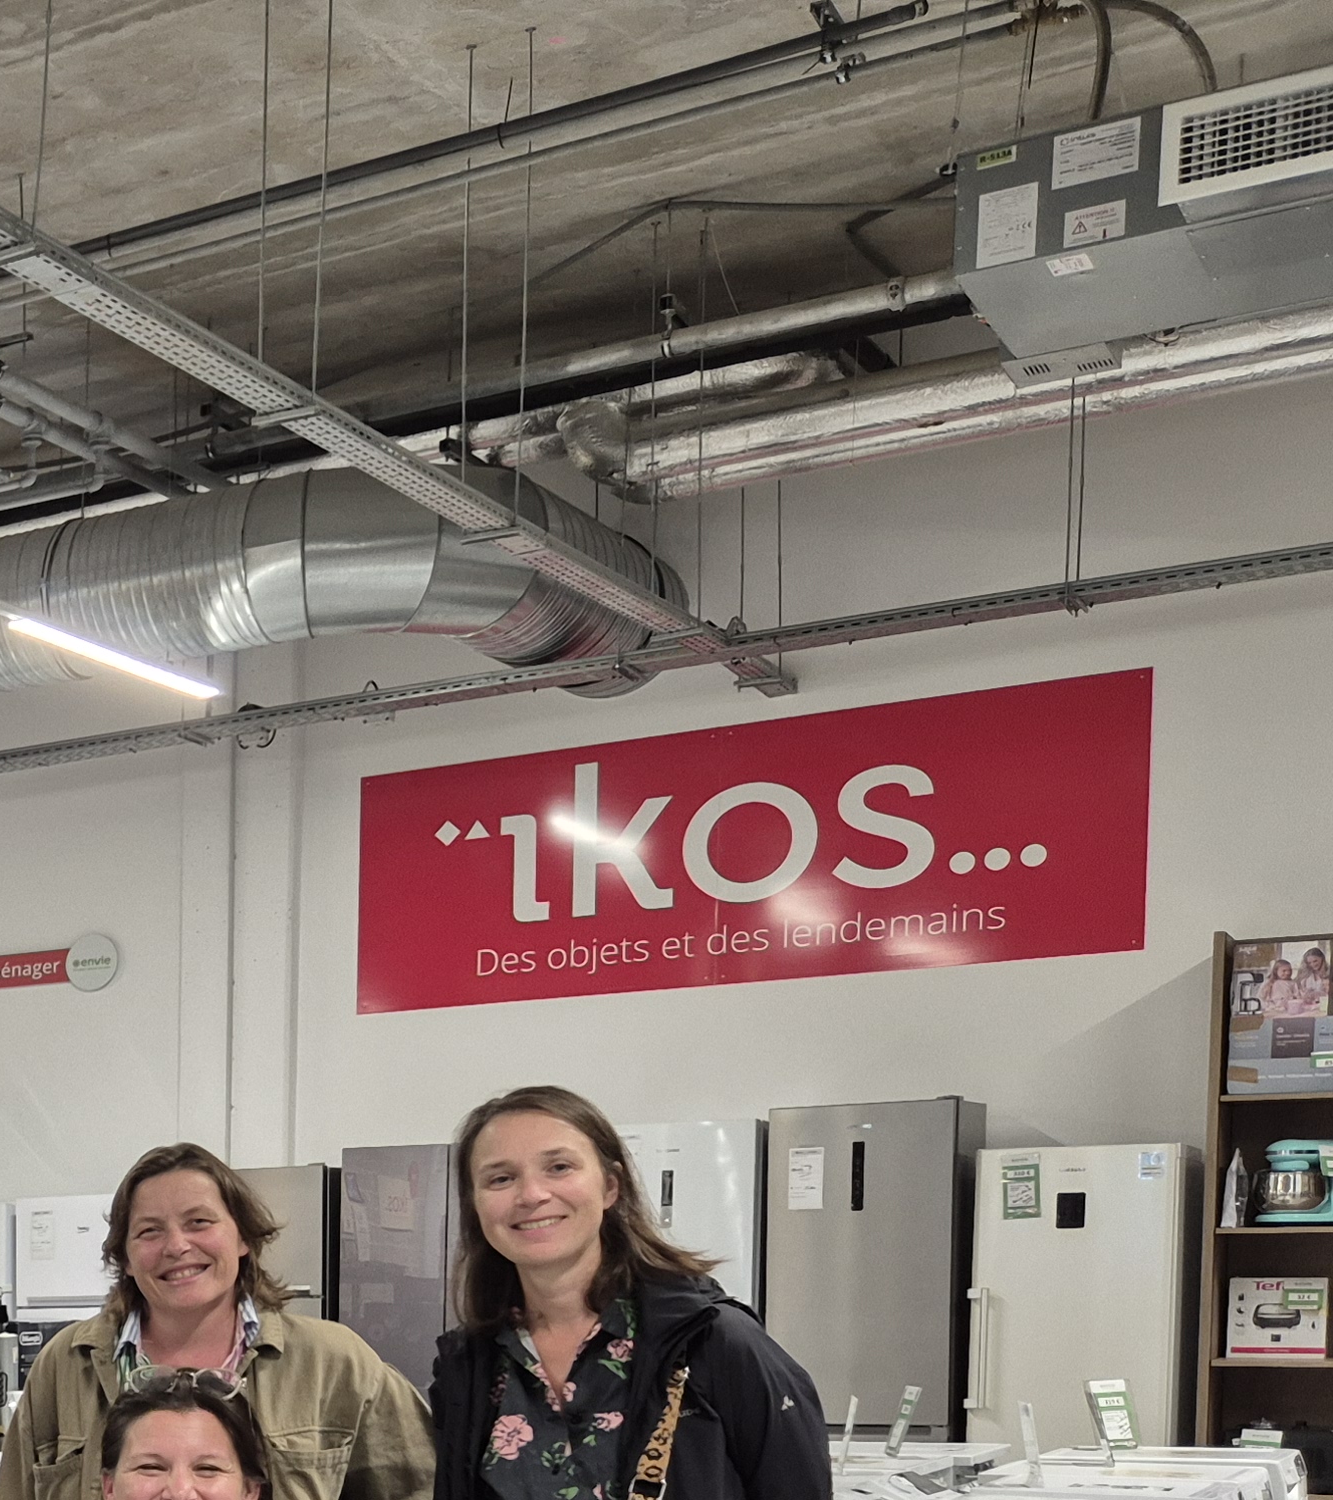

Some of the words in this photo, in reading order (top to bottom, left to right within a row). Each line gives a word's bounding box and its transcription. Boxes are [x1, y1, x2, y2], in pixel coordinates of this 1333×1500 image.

[475, 947, 538, 977] Des
[546, 930, 650, 974] objets
[662, 930, 695, 960] et
[707, 923, 770, 956] des
[782, 902, 1007, 949] lendemains
[1252, 1280, 1285, 1291] Tef
